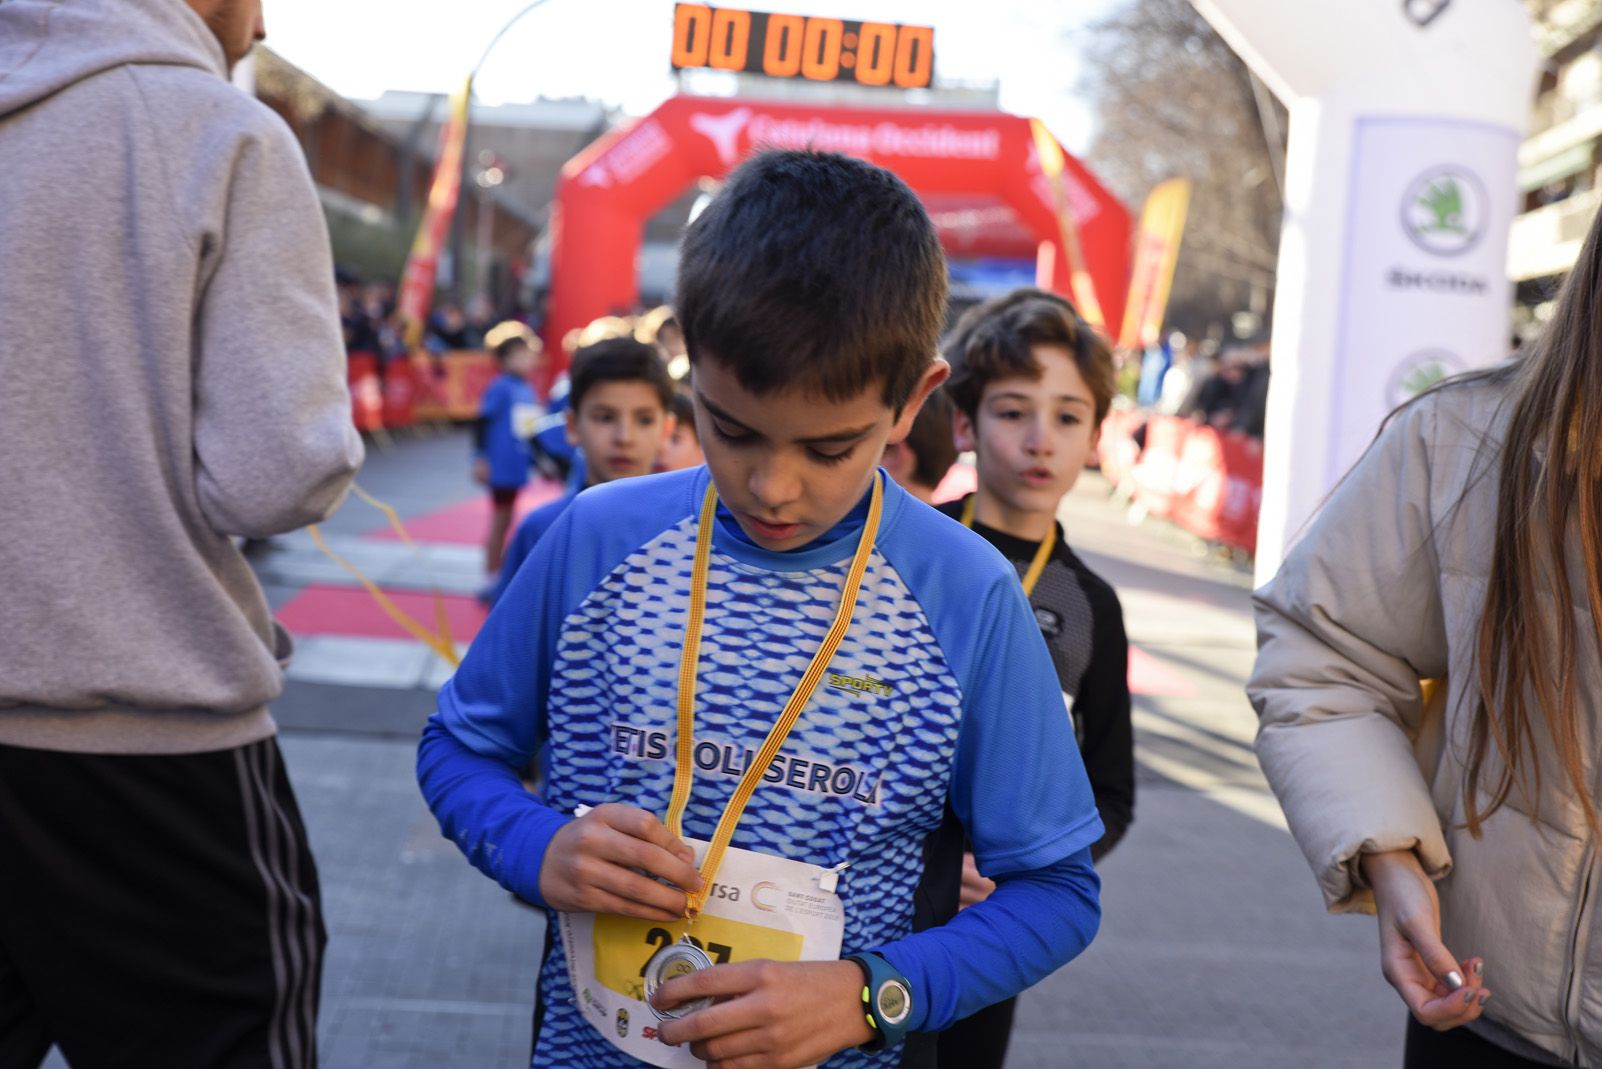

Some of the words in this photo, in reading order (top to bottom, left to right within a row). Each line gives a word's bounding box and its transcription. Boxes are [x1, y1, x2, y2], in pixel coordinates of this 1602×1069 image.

[671, 3, 750, 72] 00
[763, 12, 934, 88] 00:00
[710, 882, 741, 902] rsa
[639, 927, 733, 978] 27
